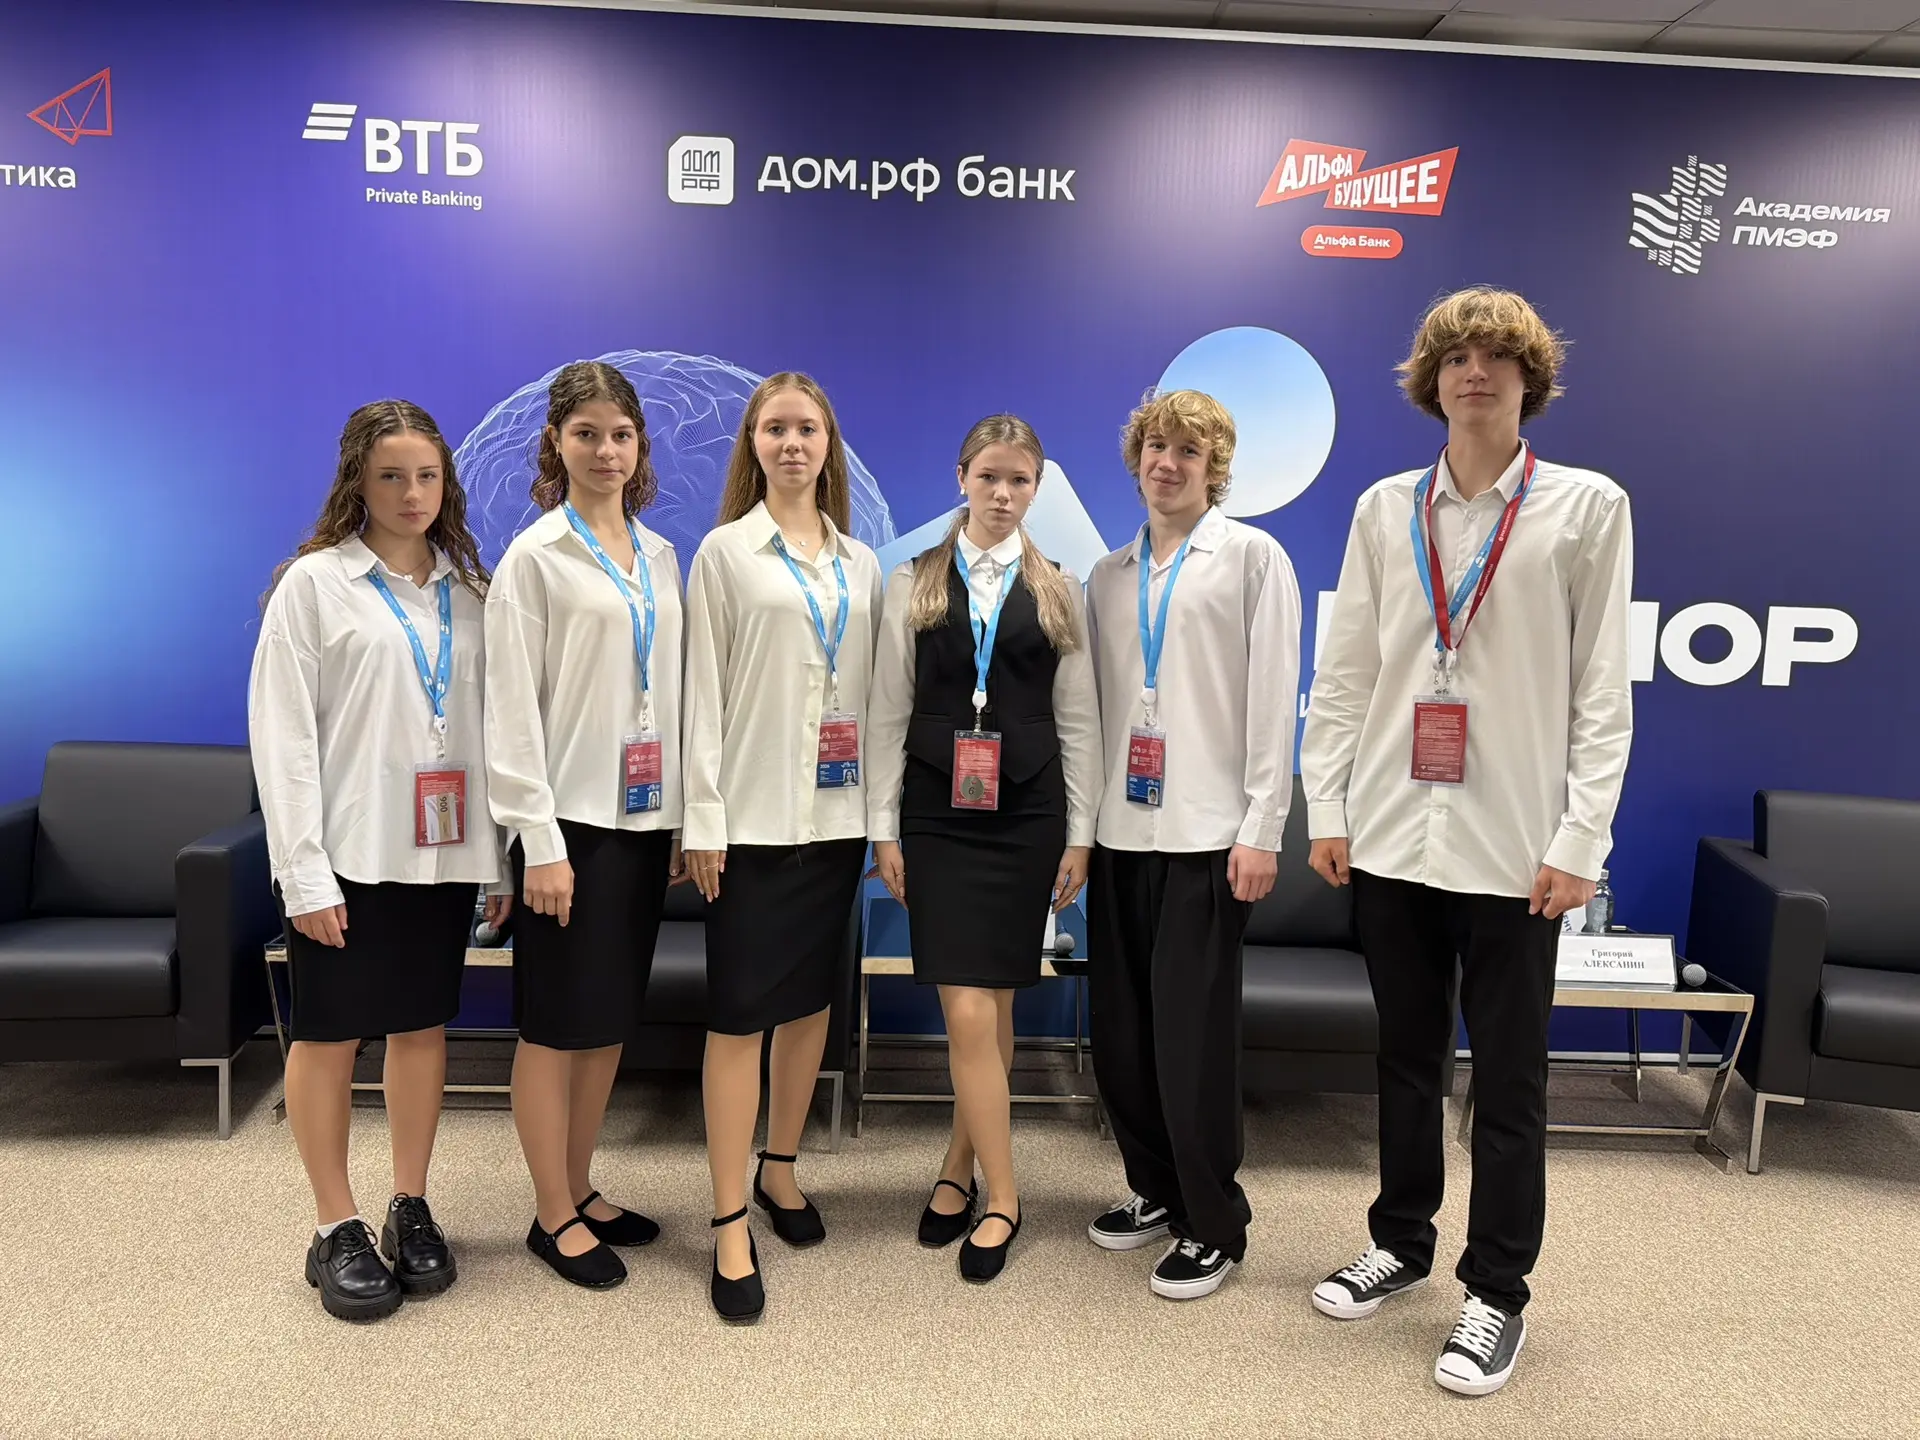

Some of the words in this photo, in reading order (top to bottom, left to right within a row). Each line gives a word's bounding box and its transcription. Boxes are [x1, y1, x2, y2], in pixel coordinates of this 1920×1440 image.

[365, 118, 484, 176] ВТБ
[957, 155, 1076, 201] банк
[1276, 153, 1353, 194] АЛЬФА
[1334, 159, 1440, 208] БУДУЩЕЕ
[366, 187, 419, 205] Private
[421, 189, 483, 211] Banking
[1733, 196, 1891, 224] Академия
[1313, 233, 1357, 250] Альфа
[1358, 235, 1391, 248] Банк
[1731, 225, 1839, 249] ПМЭФ
[1582, 959, 1645, 969] АЛЕКСАНИН
[1591, 949, 1634, 959] Григорий
